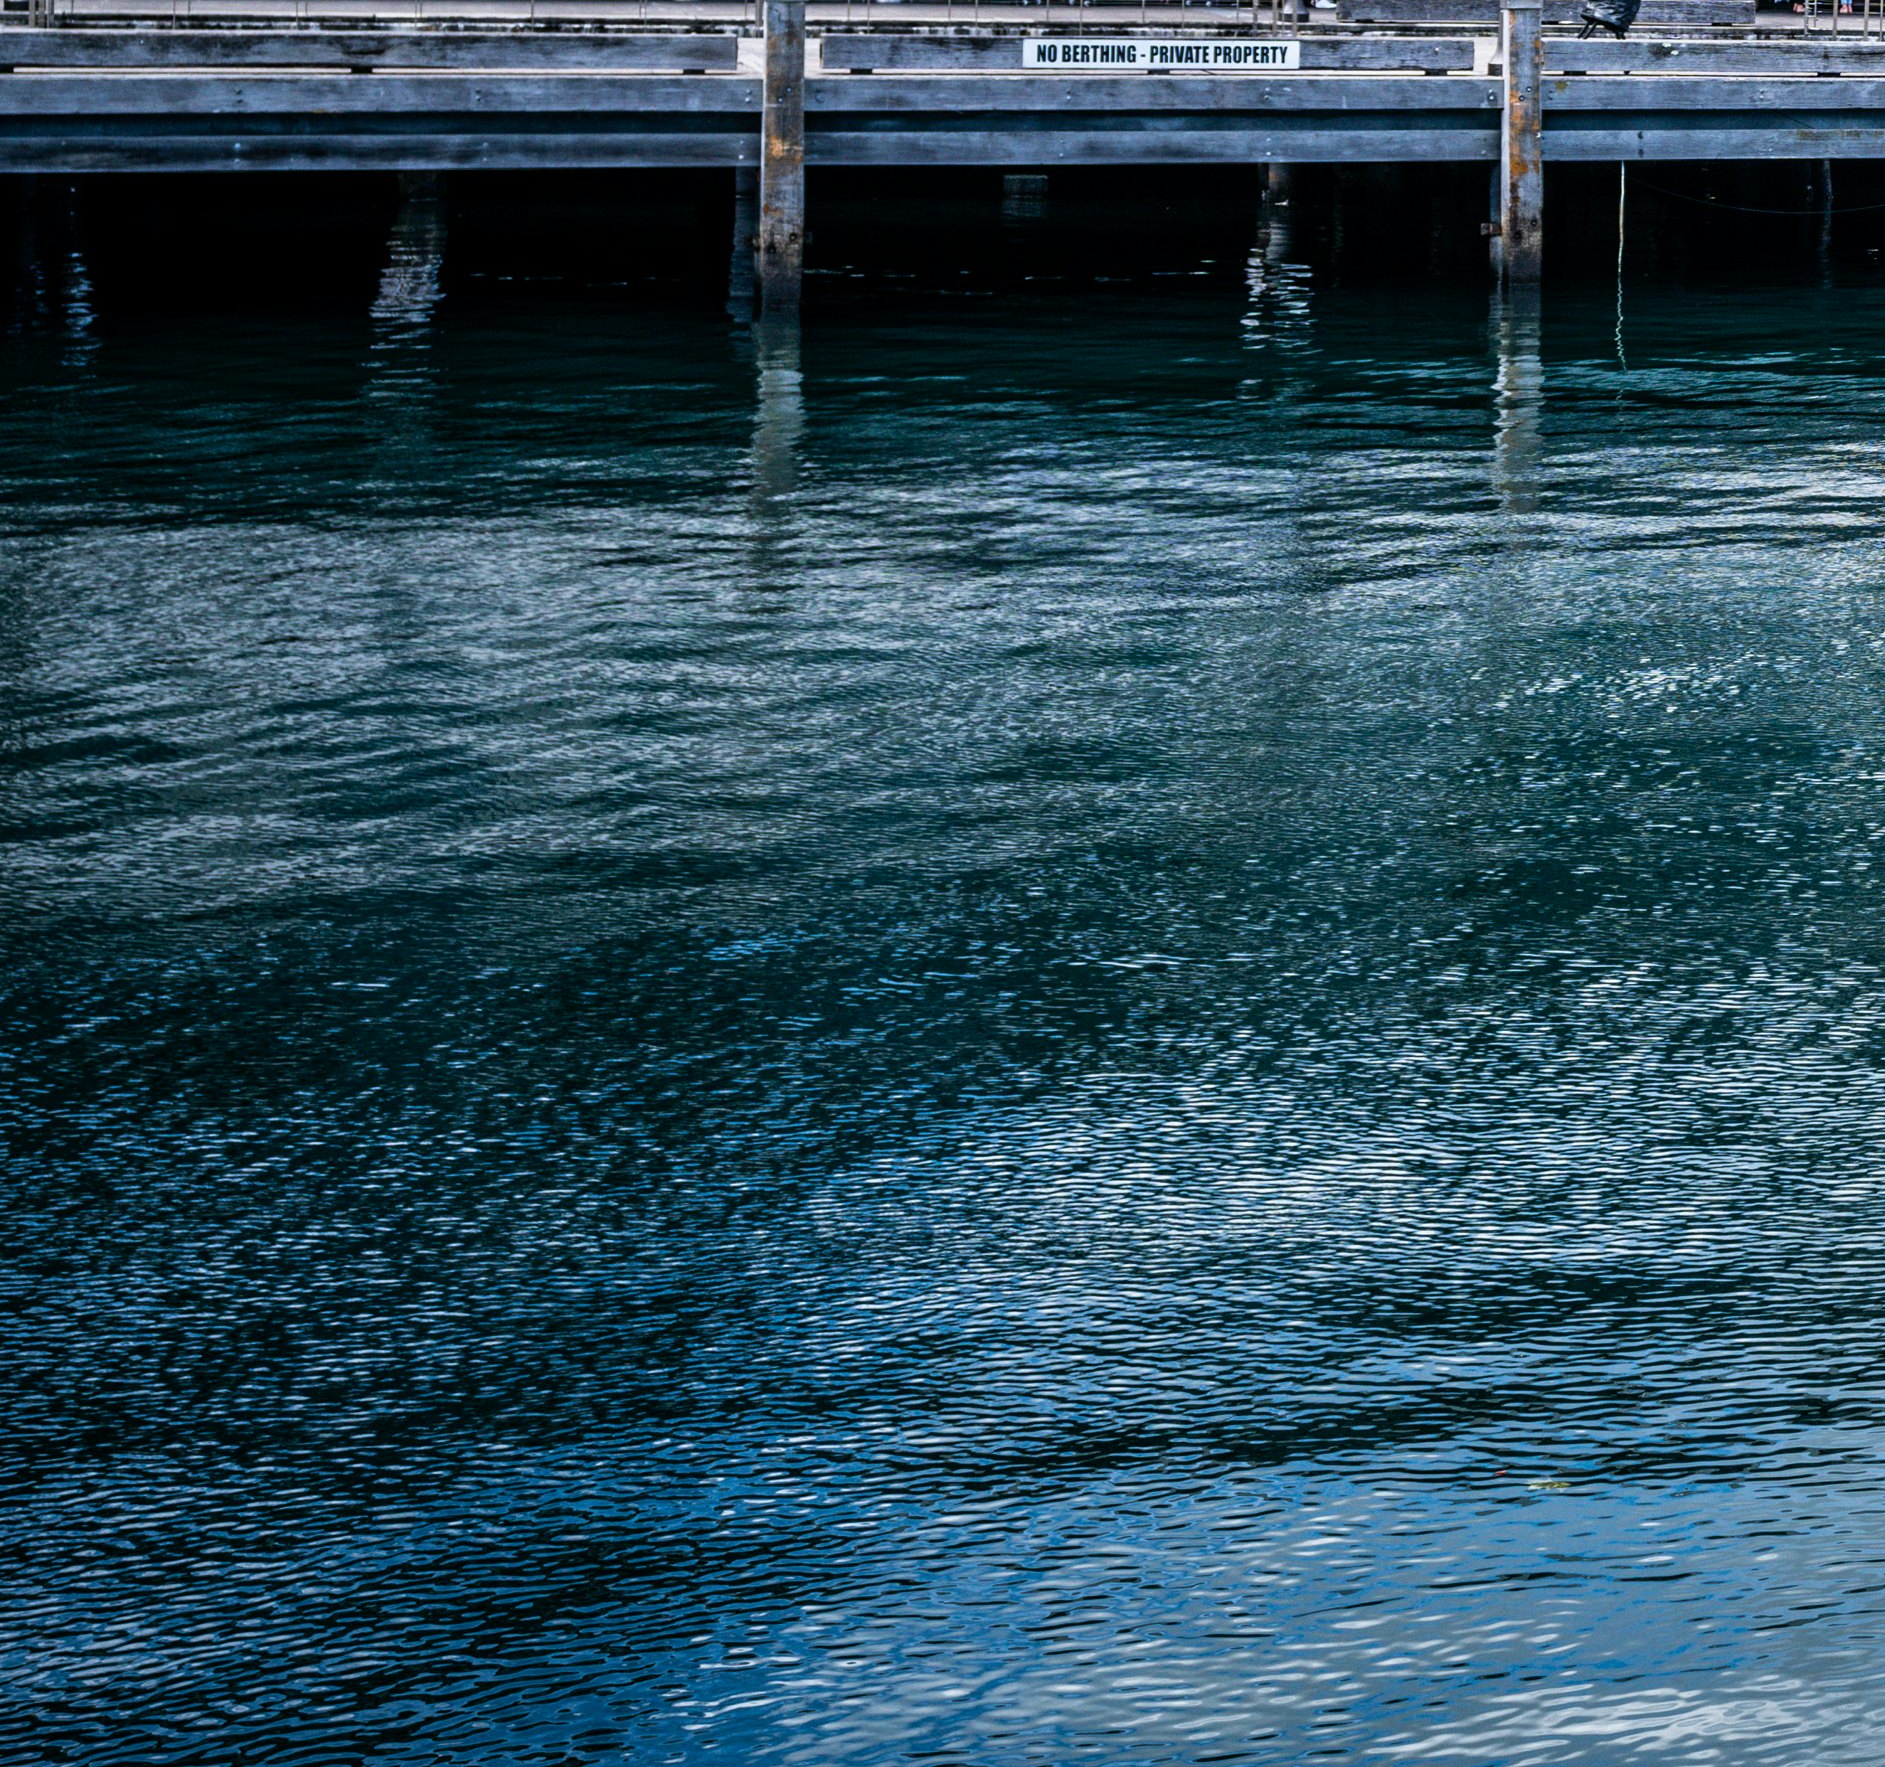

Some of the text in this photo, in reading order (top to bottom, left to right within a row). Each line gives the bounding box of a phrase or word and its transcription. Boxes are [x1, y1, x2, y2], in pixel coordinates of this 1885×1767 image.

[1037, 44, 1058, 63] NO
[1062, 44, 1137, 63] BERTHING
[1150, 45, 1210, 63] PRIVATE
[1213, 45, 1288, 64] PROPERTY
